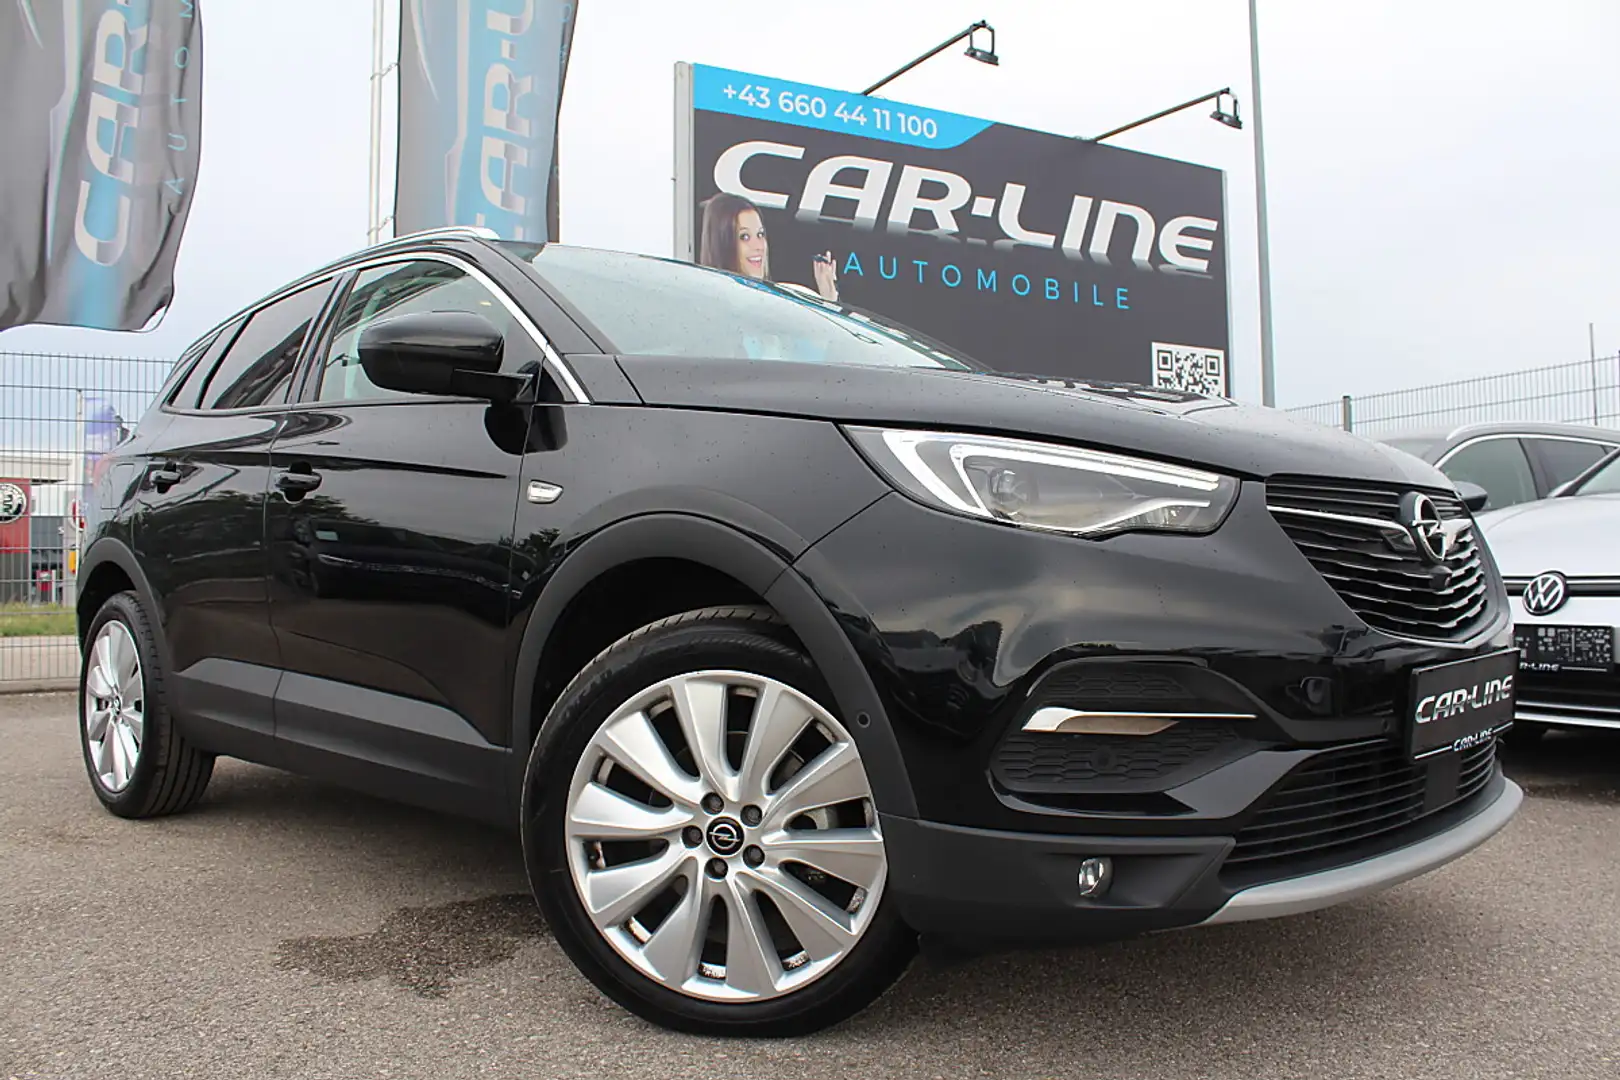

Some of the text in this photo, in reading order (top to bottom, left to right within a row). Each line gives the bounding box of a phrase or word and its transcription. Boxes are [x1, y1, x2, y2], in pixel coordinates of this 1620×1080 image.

[74, 0, 148, 267] CAR
[723, 83, 938, 139] +43 660 44 11 100
[844, 252, 1131, 310] AUTOMOBILE
